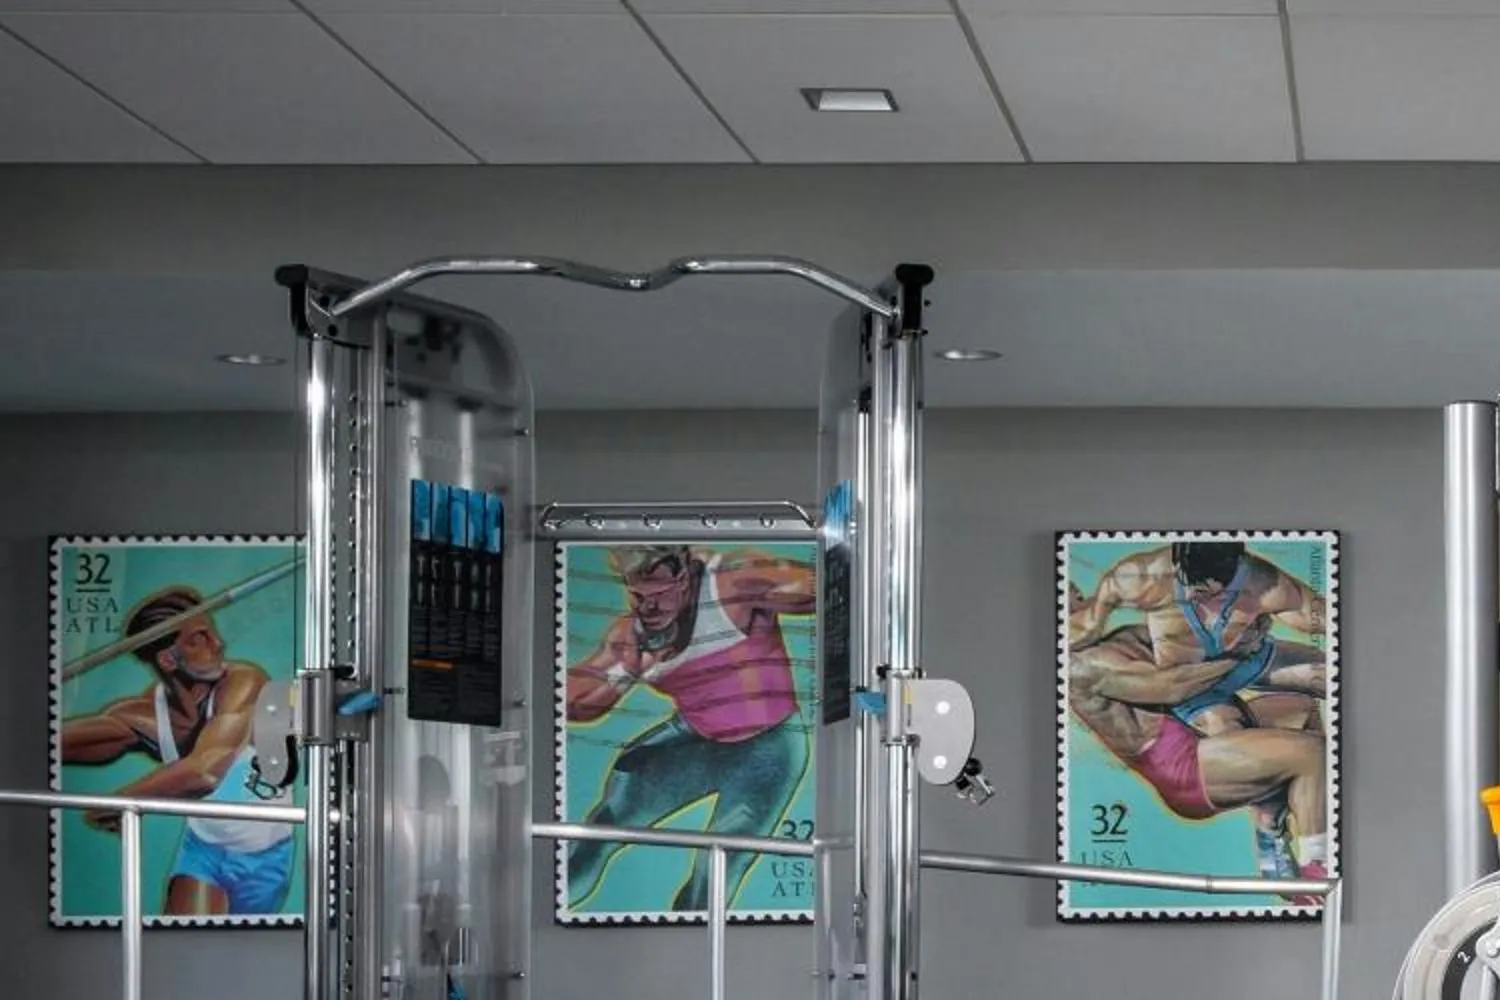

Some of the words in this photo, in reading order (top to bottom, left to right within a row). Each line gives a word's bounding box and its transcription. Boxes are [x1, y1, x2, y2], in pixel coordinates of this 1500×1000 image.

[75, 552, 114, 585] 32
[66, 597, 120, 615] USA
[64, 616, 121, 634] ATL
[1090, 803, 1130, 836] 32
[1080, 850, 1135, 868] USA
